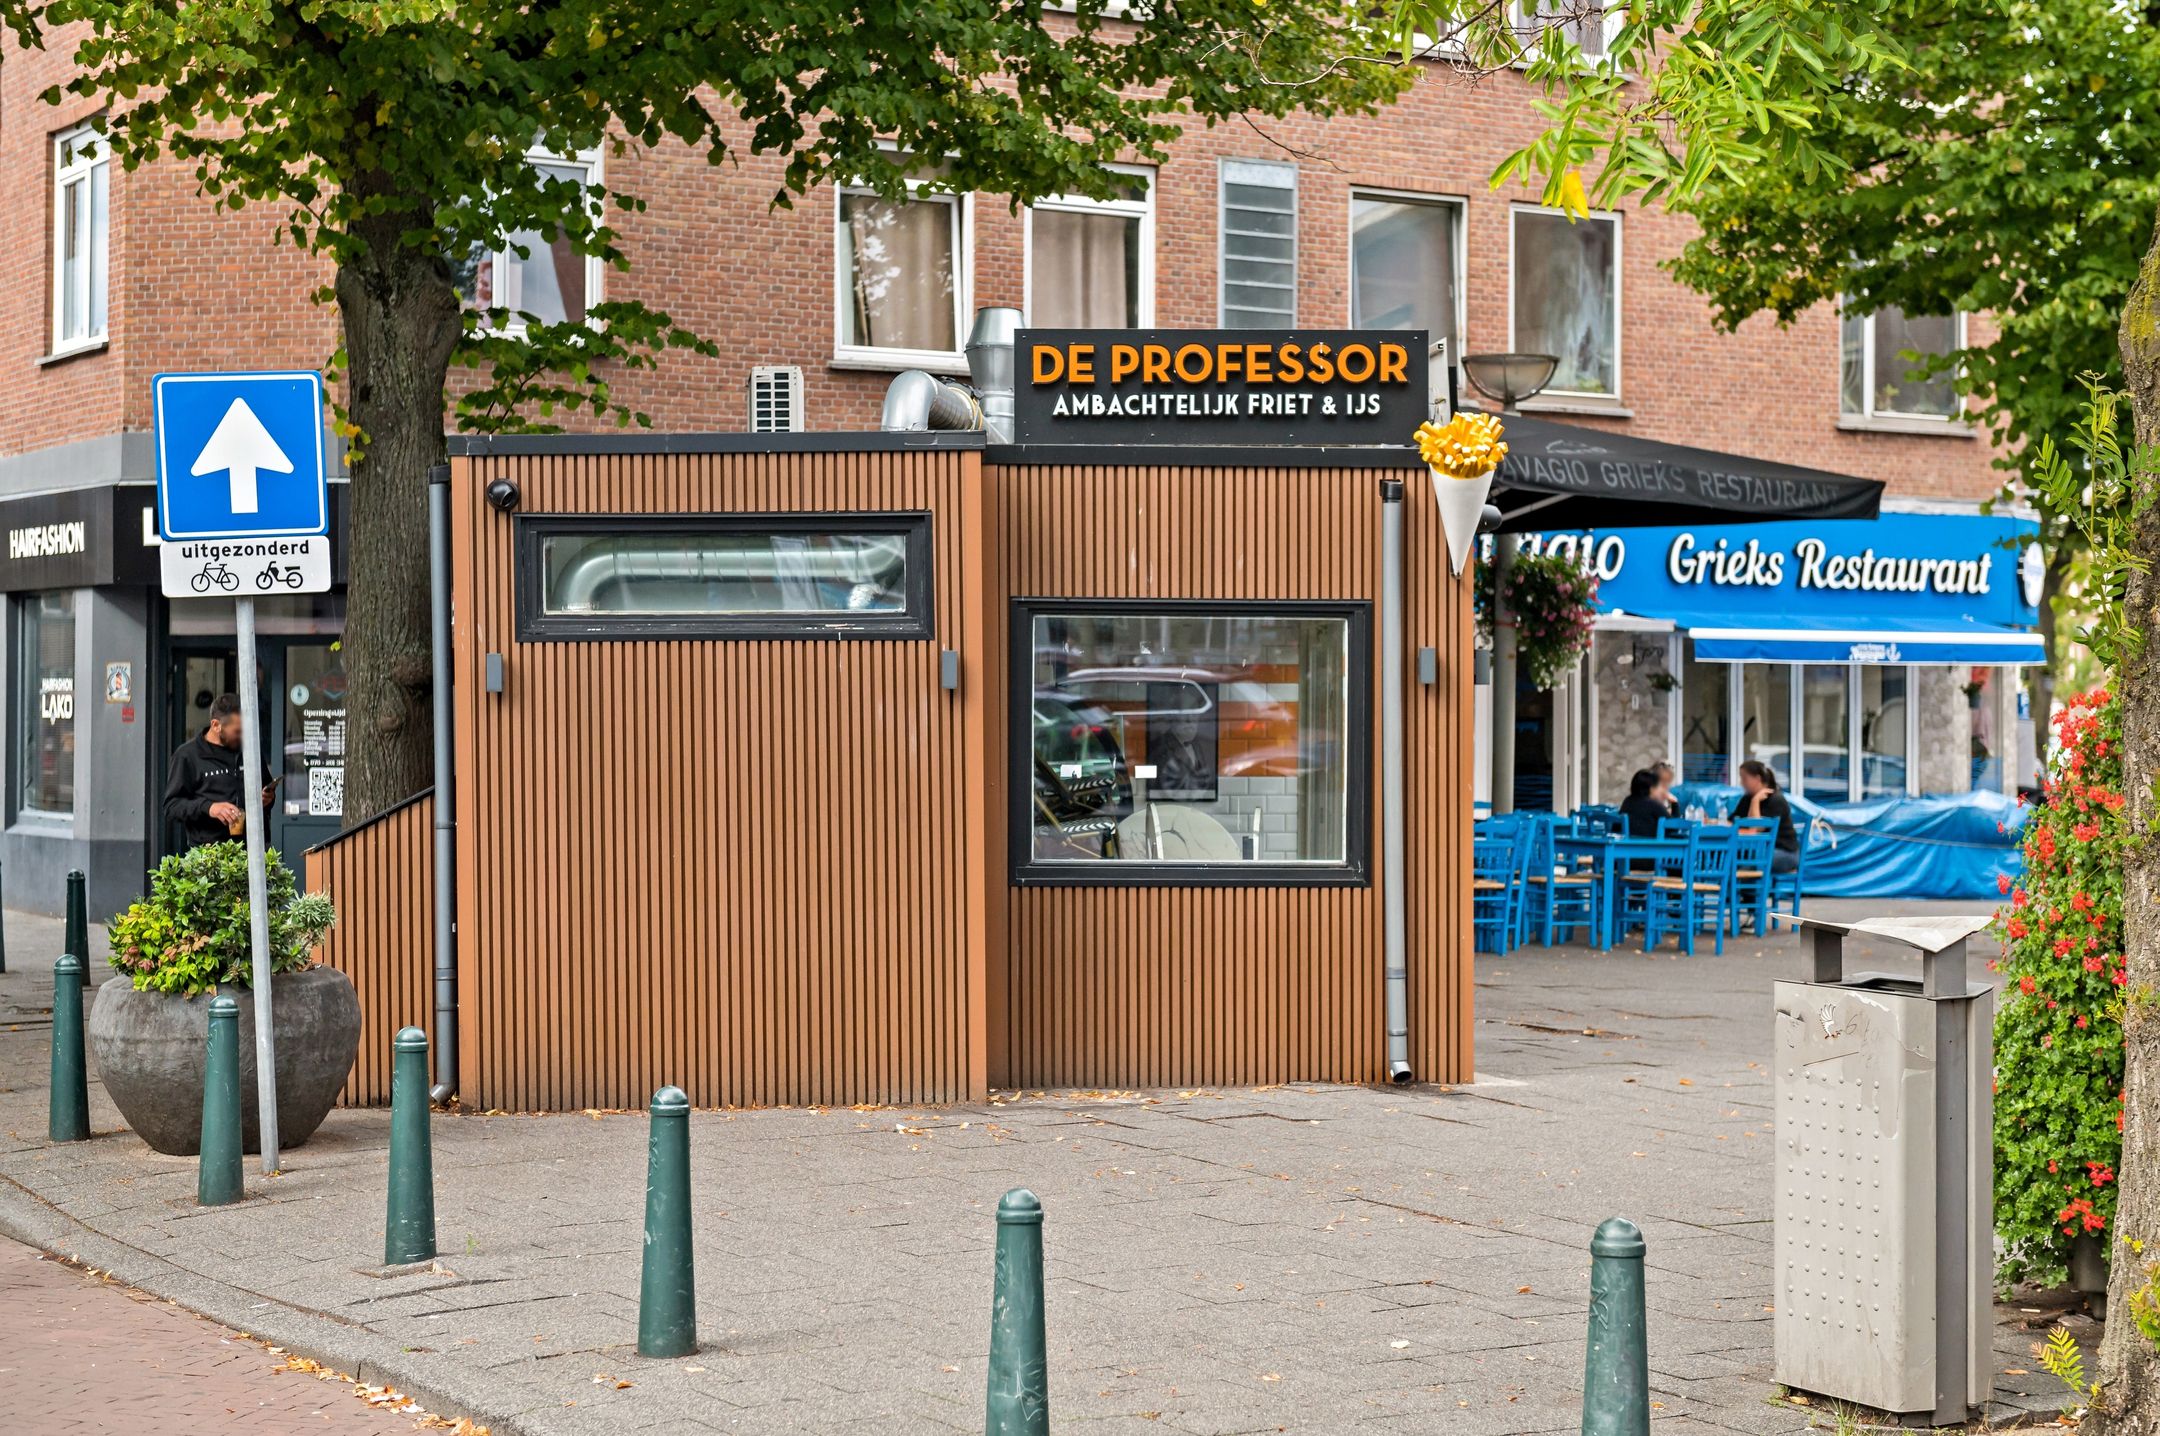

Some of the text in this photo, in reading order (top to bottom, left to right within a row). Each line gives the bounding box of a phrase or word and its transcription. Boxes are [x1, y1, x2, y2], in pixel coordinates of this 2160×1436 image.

[1033, 343, 1409, 384] DE PROFESSOR
[1052, 393, 1381, 416] AMBACHTELIJK FRIET & IJS
[1500, 454, 1841, 507] AVAGIO GRIEKS RESTAURANT
[9, 521, 85, 559] HAIRFASHION
[181, 539, 310, 562] uitgezonderd
[1669, 533, 1785, 586] Grieks
[1796, 538, 1993, 595] Restaurant
